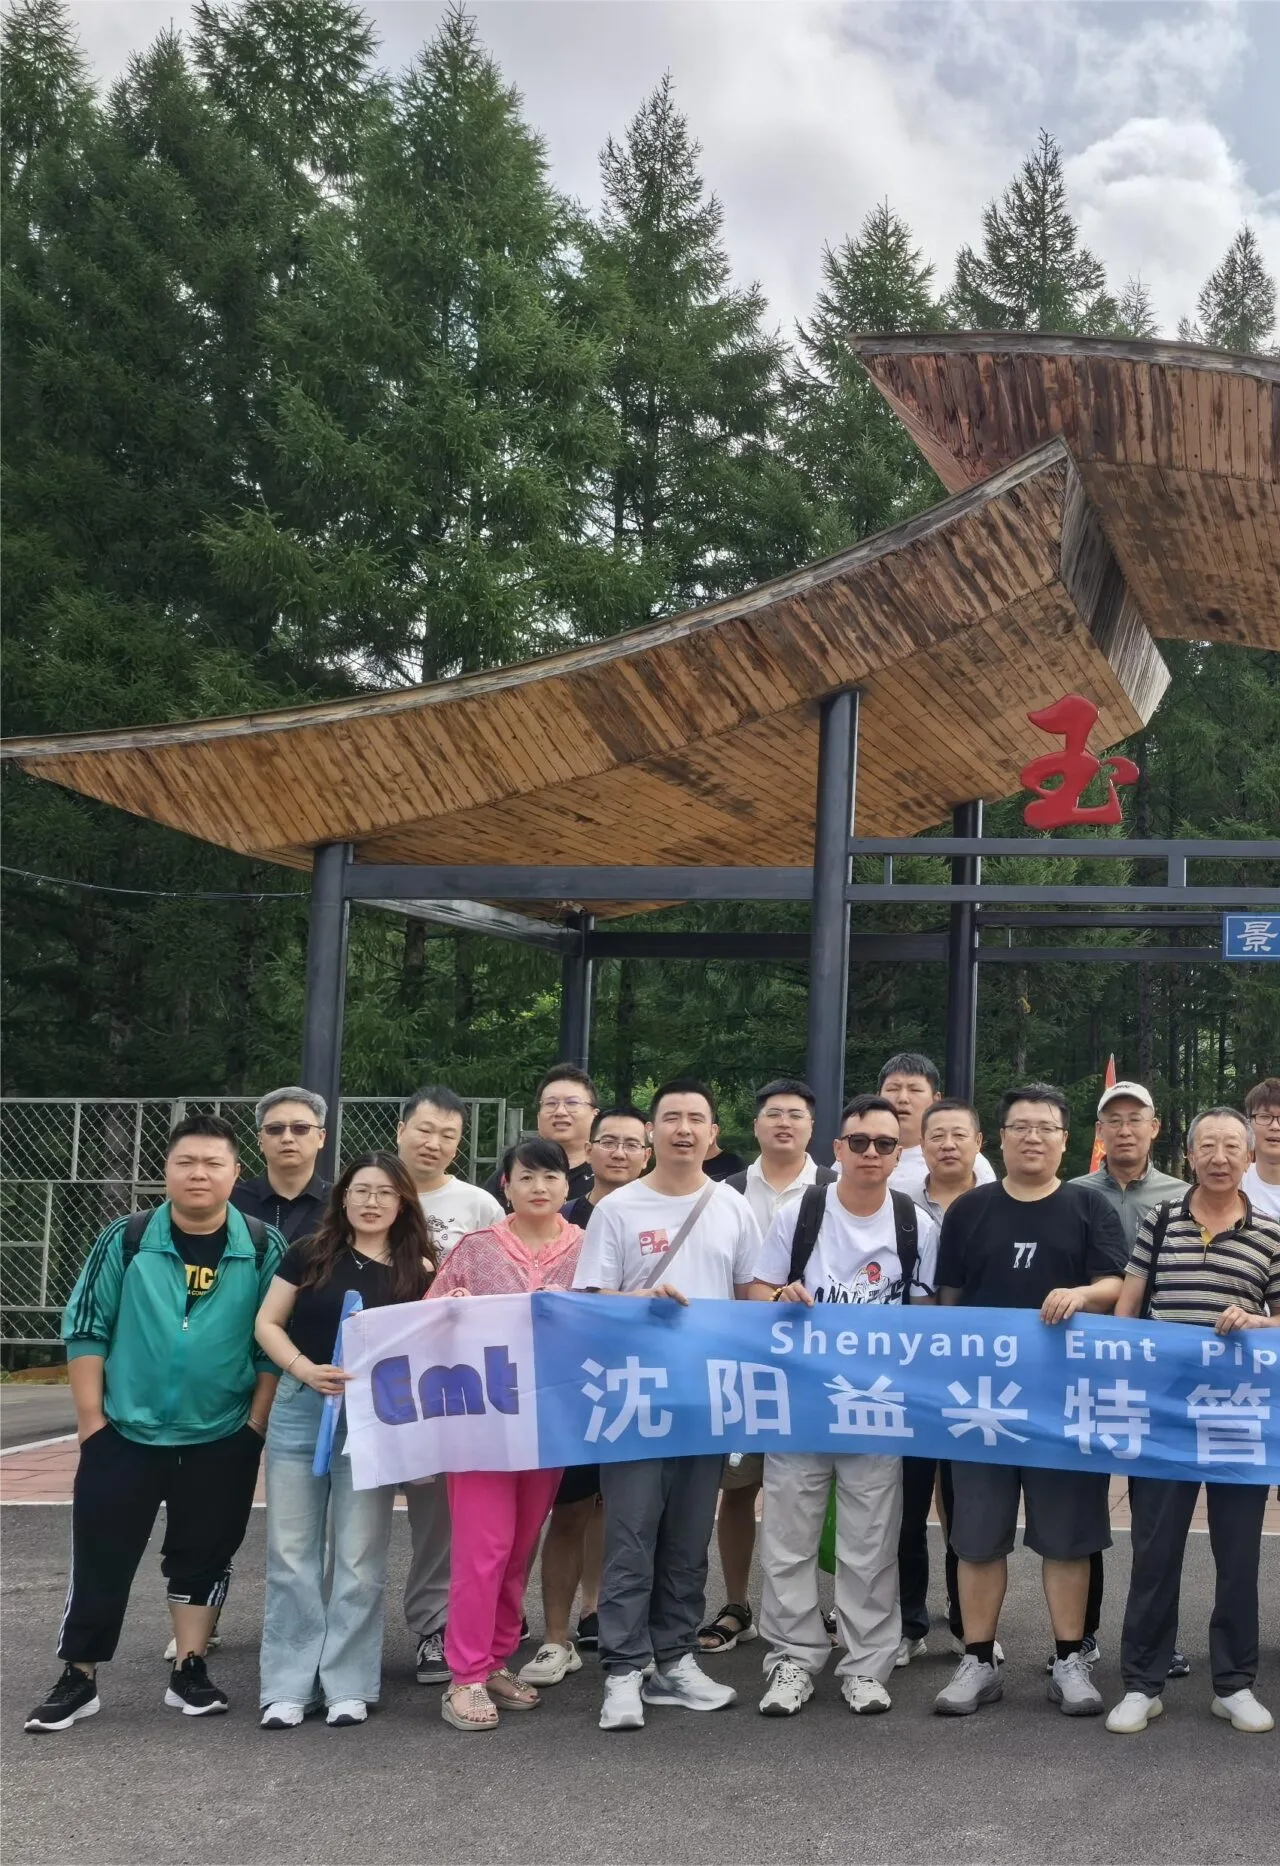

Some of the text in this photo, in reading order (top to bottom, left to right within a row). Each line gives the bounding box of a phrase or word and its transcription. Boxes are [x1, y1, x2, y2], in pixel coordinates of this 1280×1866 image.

[1013, 1242, 1037, 1269] 77
[770, 1320, 1019, 1367] Shenyang
[1065, 1329, 1157, 1363] Emt
